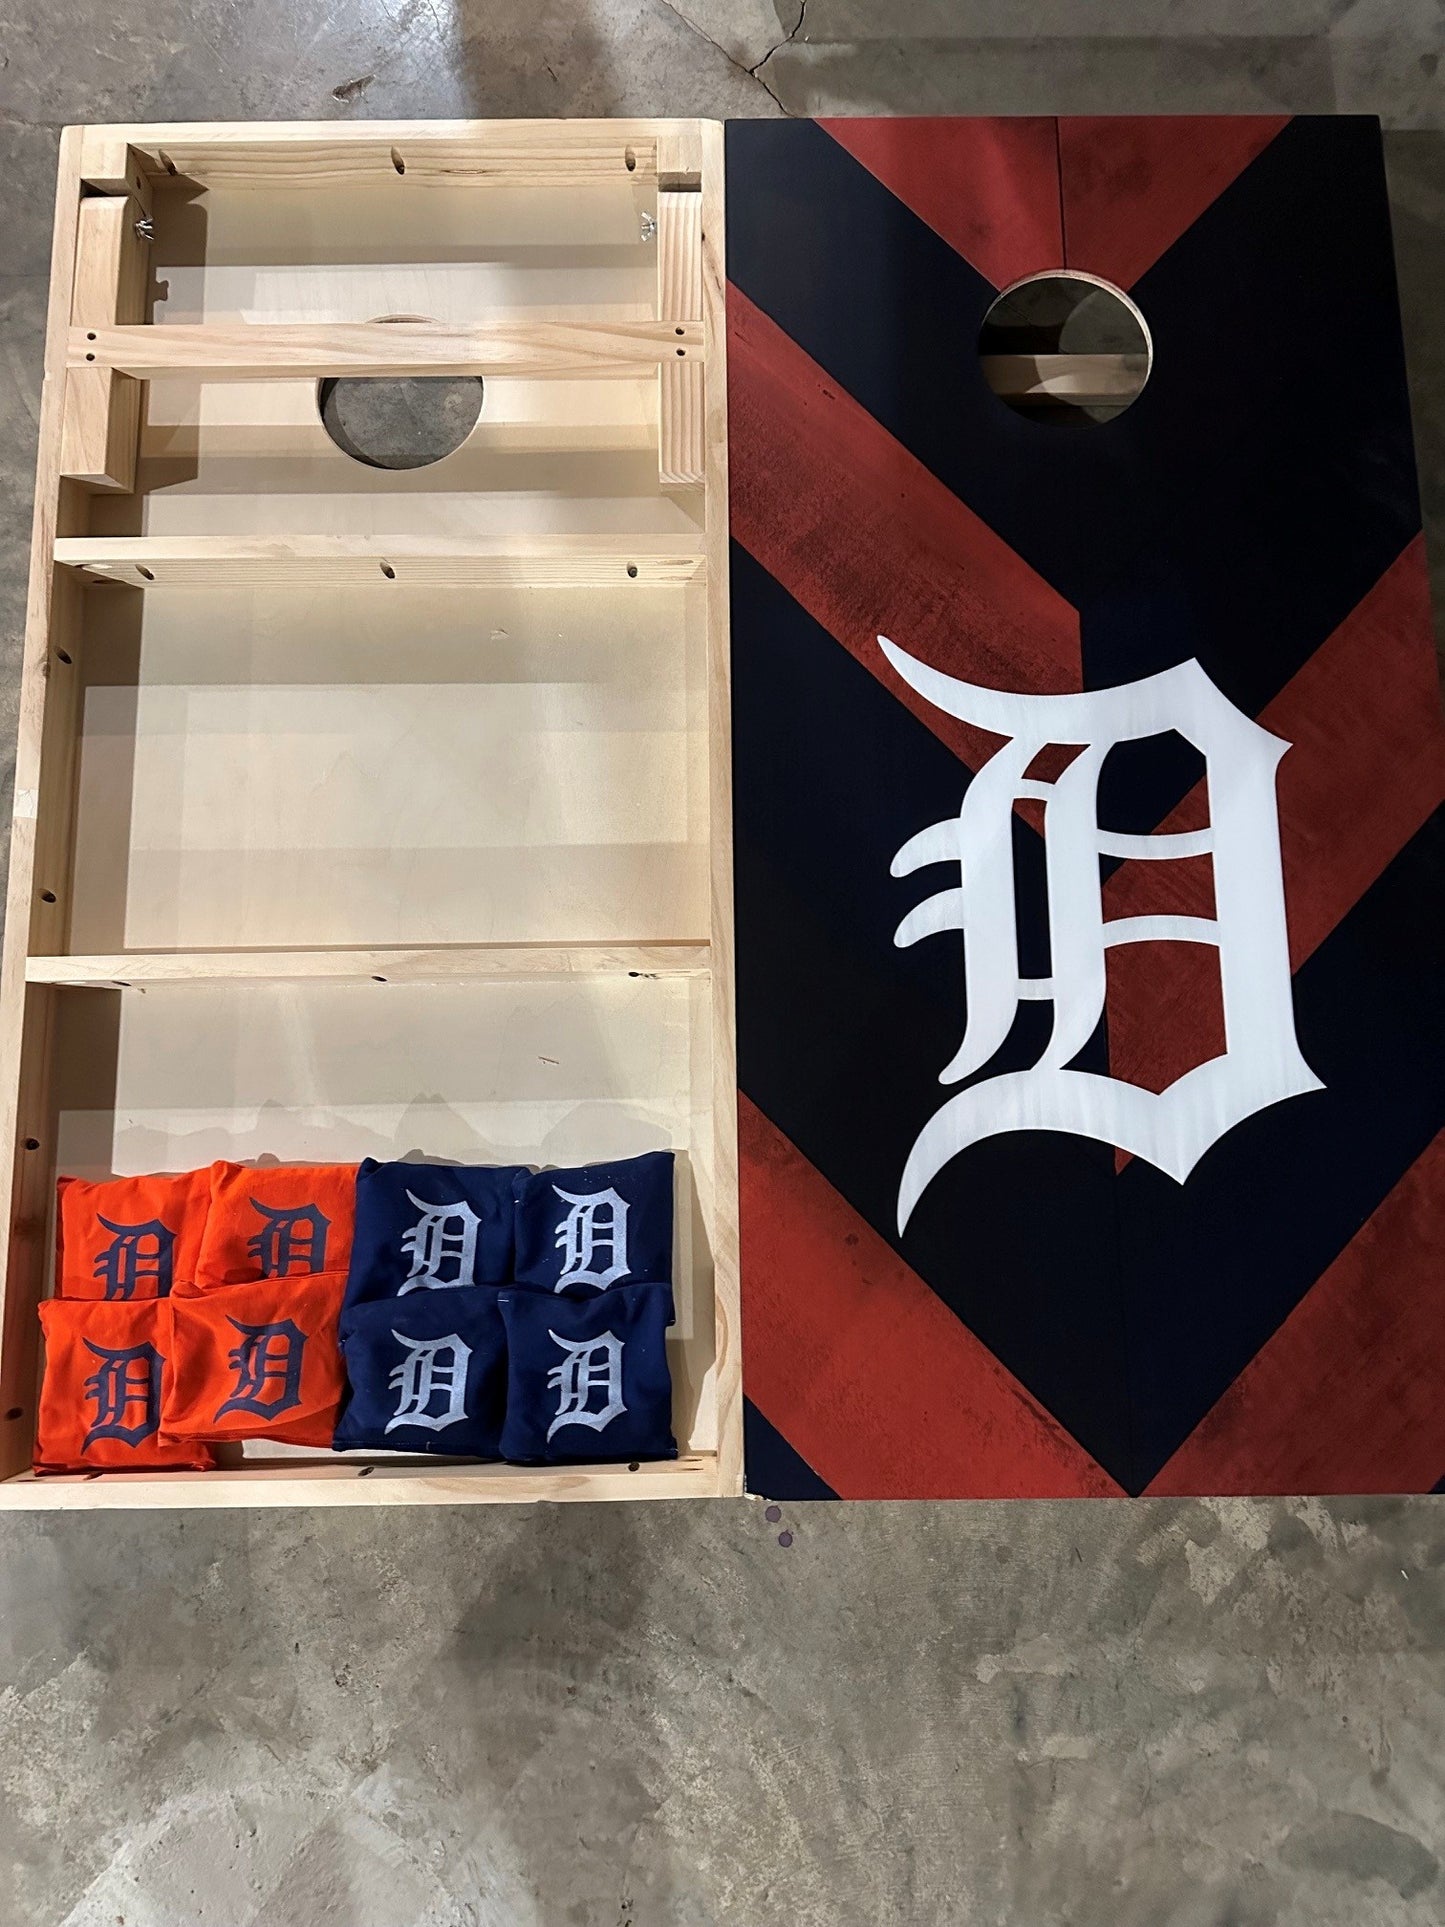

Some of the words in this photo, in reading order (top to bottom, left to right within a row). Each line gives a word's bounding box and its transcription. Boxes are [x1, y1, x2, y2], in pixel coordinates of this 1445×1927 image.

[877, 635, 1327, 1238] D
[400, 1189, 482, 1296] D
[551, 1185, 632, 1293] D
[82, 1337, 165, 1455] D
[213, 1314, 307, 1424] D
[384, 1329, 474, 1434] D
[547, 1329, 627, 1443] D
